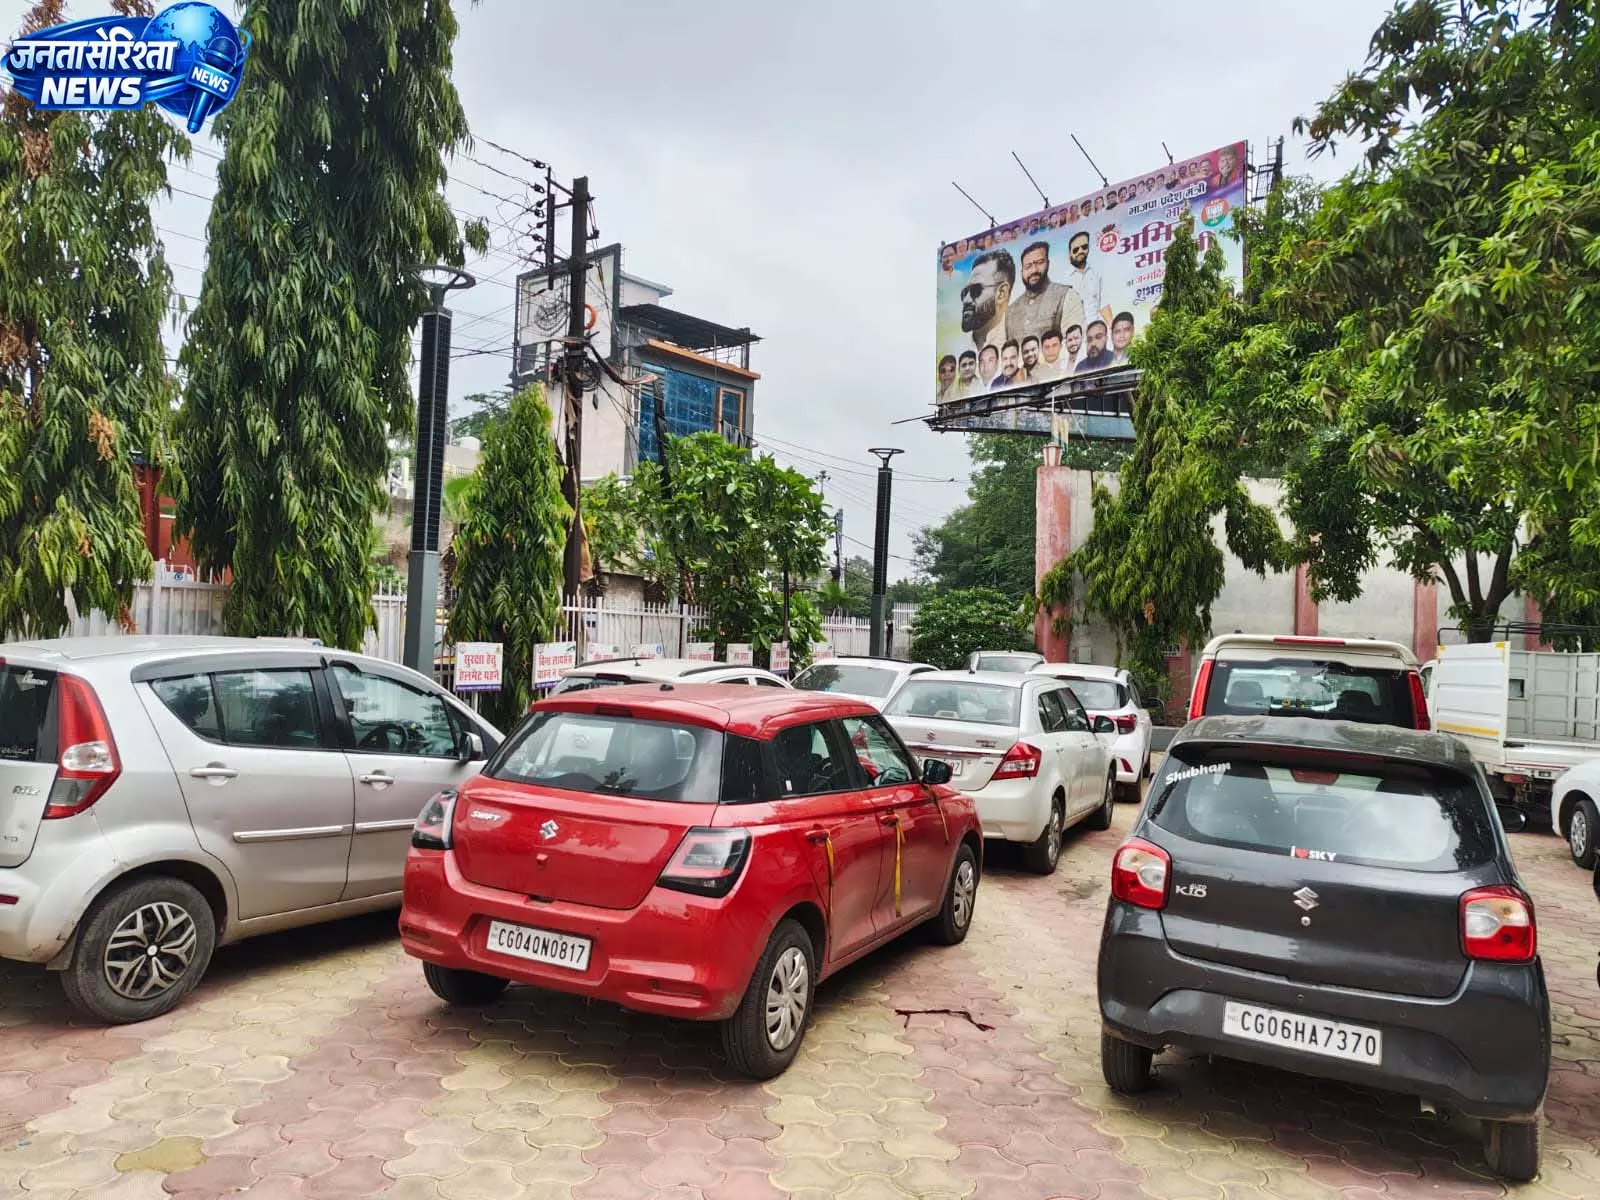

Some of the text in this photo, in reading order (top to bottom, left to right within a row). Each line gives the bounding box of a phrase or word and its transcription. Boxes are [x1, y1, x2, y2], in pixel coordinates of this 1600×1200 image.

[1128, 181, 1206, 216] भाजपा प्रदेश मंत्री
[1117, 221, 1187, 255] अमि
[1165, 762, 1231, 785] Shubham
[1308, 851, 1337, 862] SKY
[1241, 1011, 1376, 1056] CG06HA7370
